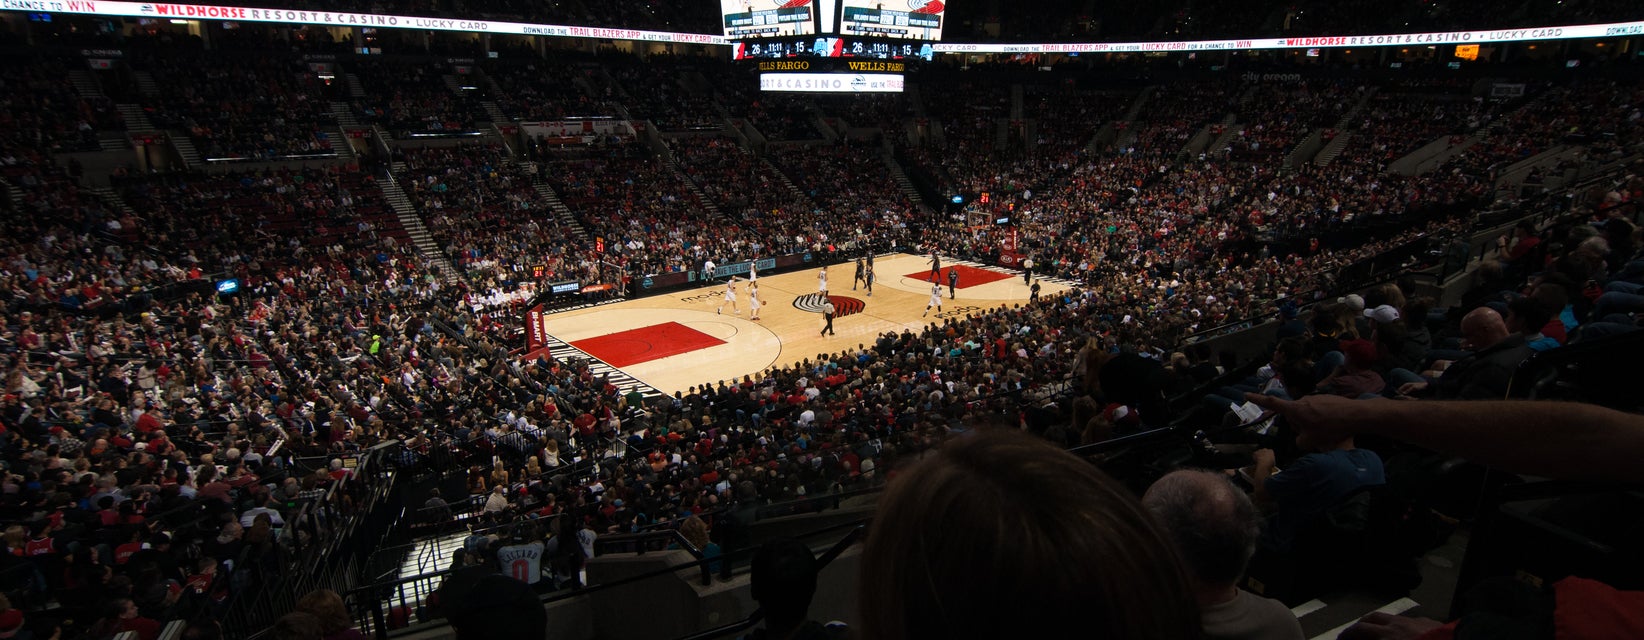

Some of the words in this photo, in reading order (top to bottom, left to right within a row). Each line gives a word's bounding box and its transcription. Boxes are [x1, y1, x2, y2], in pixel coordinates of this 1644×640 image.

[3, 0, 46, 10] CHANCE
[50, 2, 63, 11] TO
[67, 0, 96, 12] WIN
[155, 4, 246, 18] WILDHORSE
[252, 9, 318, 21] RESORT
[324, 13, 332, 22] &
[337, 14, 398, 25] CASINO
[416, 19, 454, 28] LUCKY
[460, 21, 488, 30] CARD
[1606, 25, 1643, 36] DOWNLOAD
[523, 27, 555, 35] DOWNLOAD
[569, 27, 591, 37] TRAIL
[593, 28, 625, 38] BLAZERS
[627, 31, 641, 39] APP
[672, 33, 693, 42] LUCKY
[694, 35, 711, 43] CARD
[1286, 37, 1347, 46] WILDHORSE
[1350, 36, 1402, 44] RESORT
[1405, 35, 1412, 43] &
[1416, 33, 1472, 42] CASINO
[1489, 30, 1527, 40] LUCKY
[1531, 28, 1563, 38] CARD
[751, 44, 760, 54] 26
[768, 43, 782, 51] 11:11
[795, 42, 805, 52] 15
[852, 42, 863, 53] 26
[873, 43, 888, 52] 11:11
[902, 45, 912, 55] 15
[1041, 44, 1060, 52] TRAIL
[1141, 43, 1165, 51] LUCKY
[1166, 42, 1187, 50] CARD
[1236, 40, 1252, 48] WIN
[776, 61, 809, 70] FARGO
[848, 61, 886, 71] WELLS
[786, 79, 842, 89] CASINO
[980, 195, 989, 203] 21
[728, 266, 738, 274] THE
[512, 559, 529, 584] 0
